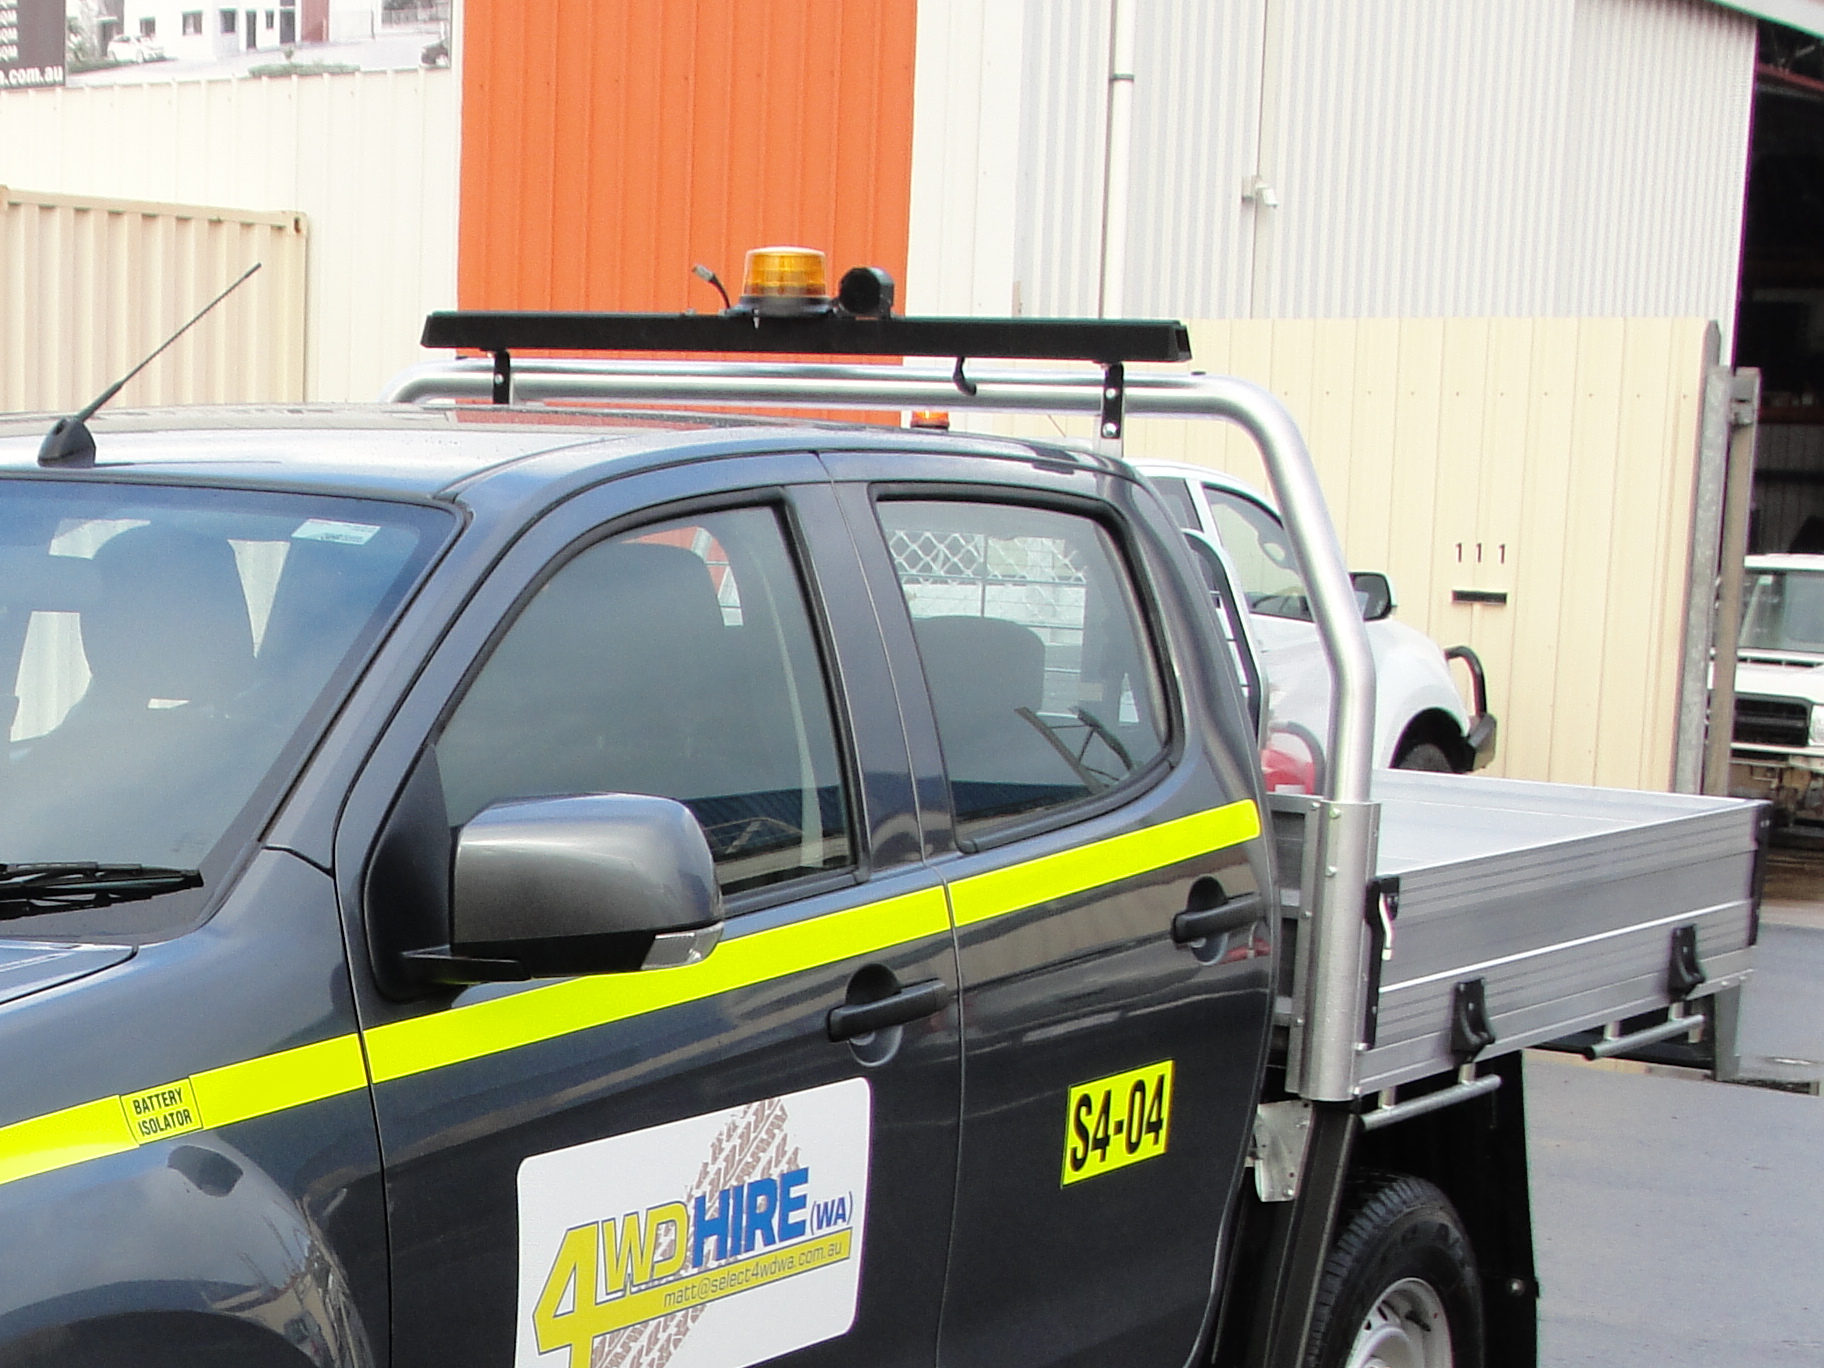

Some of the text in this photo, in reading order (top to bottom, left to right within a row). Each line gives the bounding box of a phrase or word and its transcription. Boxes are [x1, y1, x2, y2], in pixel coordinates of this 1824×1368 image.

[132, 1087, 183, 1115] BATTERY
[138, 1109, 192, 1137] ISOLATOR
[1070, 1073, 1165, 1172] S4-04
[663, 1242, 843, 1310] matt@select4wdwa.com.au
